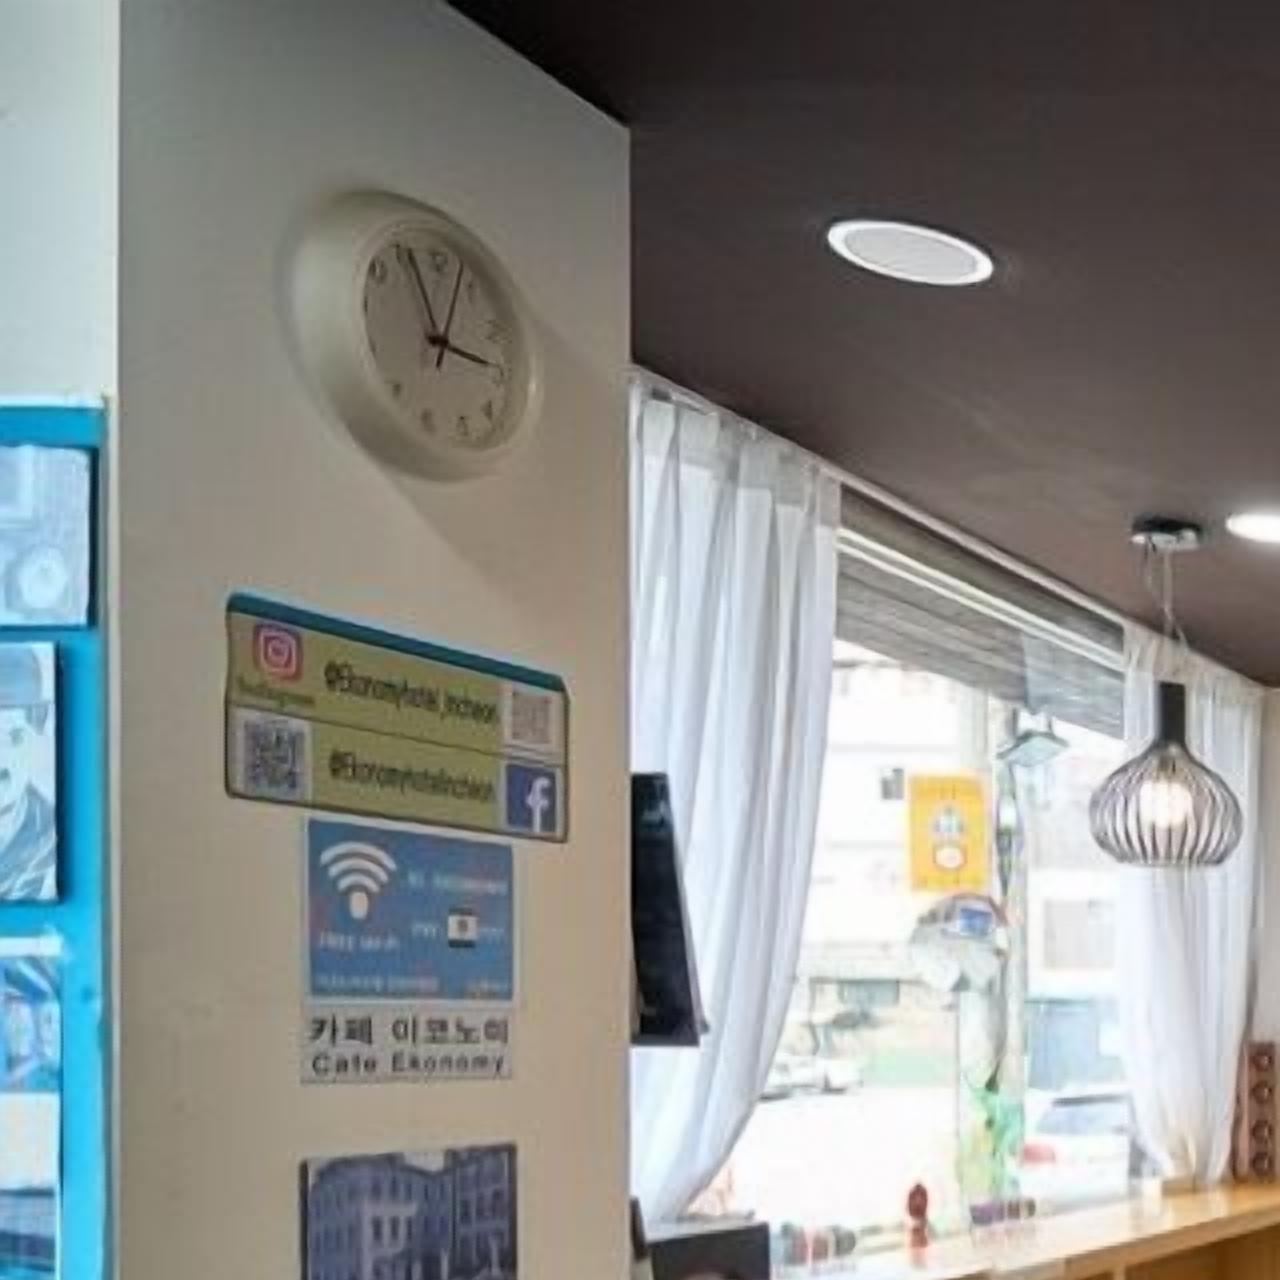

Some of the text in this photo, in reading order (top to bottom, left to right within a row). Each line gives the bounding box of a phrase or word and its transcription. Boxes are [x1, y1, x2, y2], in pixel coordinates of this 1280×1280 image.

[309, 1013, 509, 1047] 카페 이코노미
[311, 1051, 505, 1080] Cafe Ekonomy
